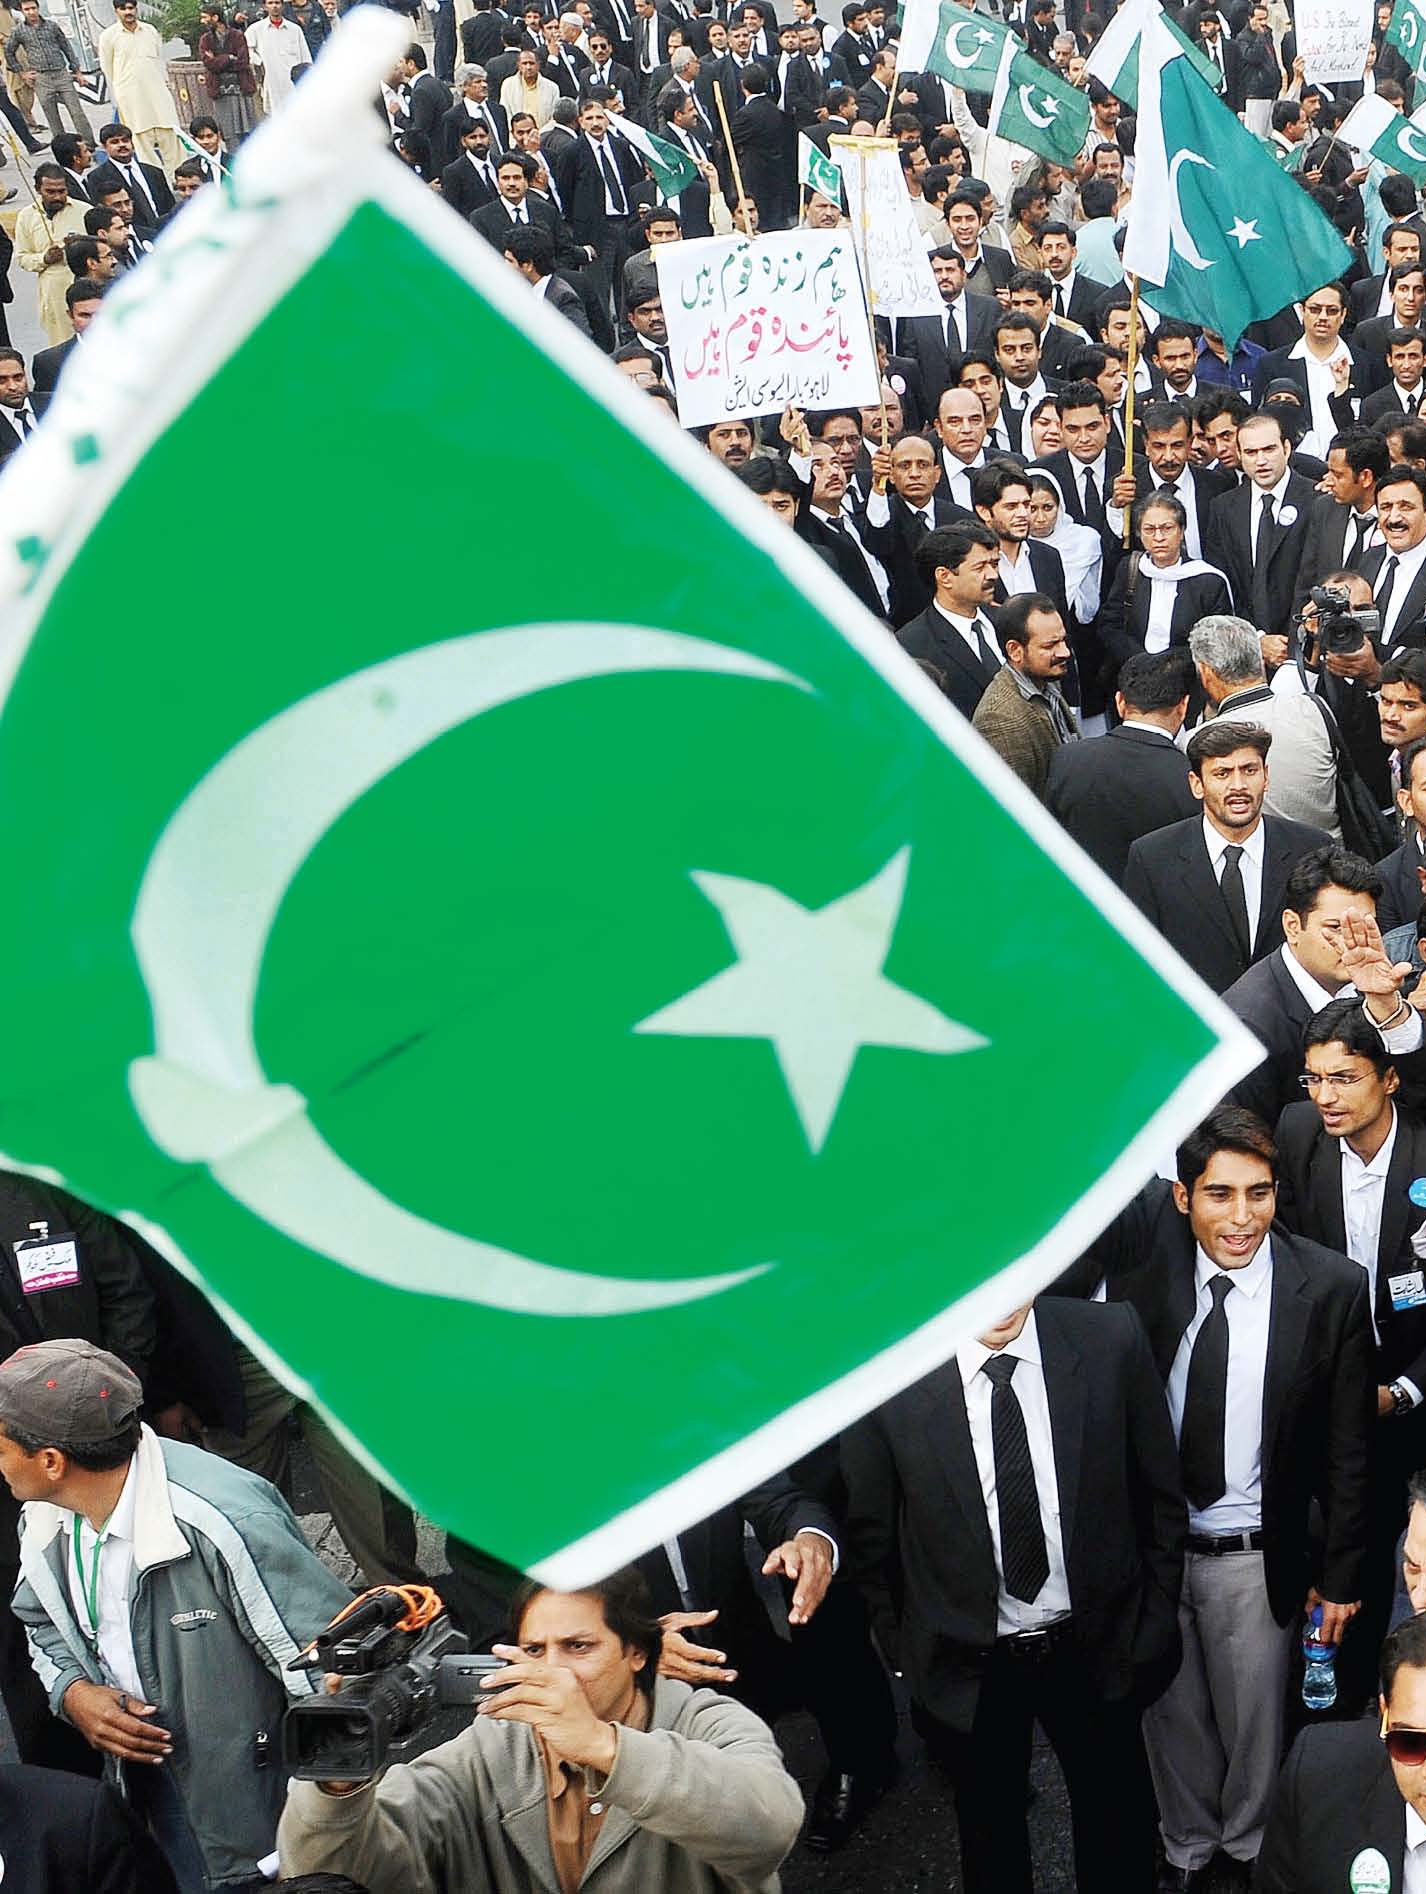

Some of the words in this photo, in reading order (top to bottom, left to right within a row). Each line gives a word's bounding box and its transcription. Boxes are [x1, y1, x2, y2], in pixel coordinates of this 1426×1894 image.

[680, 262, 714, 310] ہیں
[720, 242, 754, 312] قوم
[763, 251, 808, 294] زندہ
[683, 320, 721, 380] ہیں
[724, 306, 768, 379] قوم
[804, 373, 831, 401] لاہور
